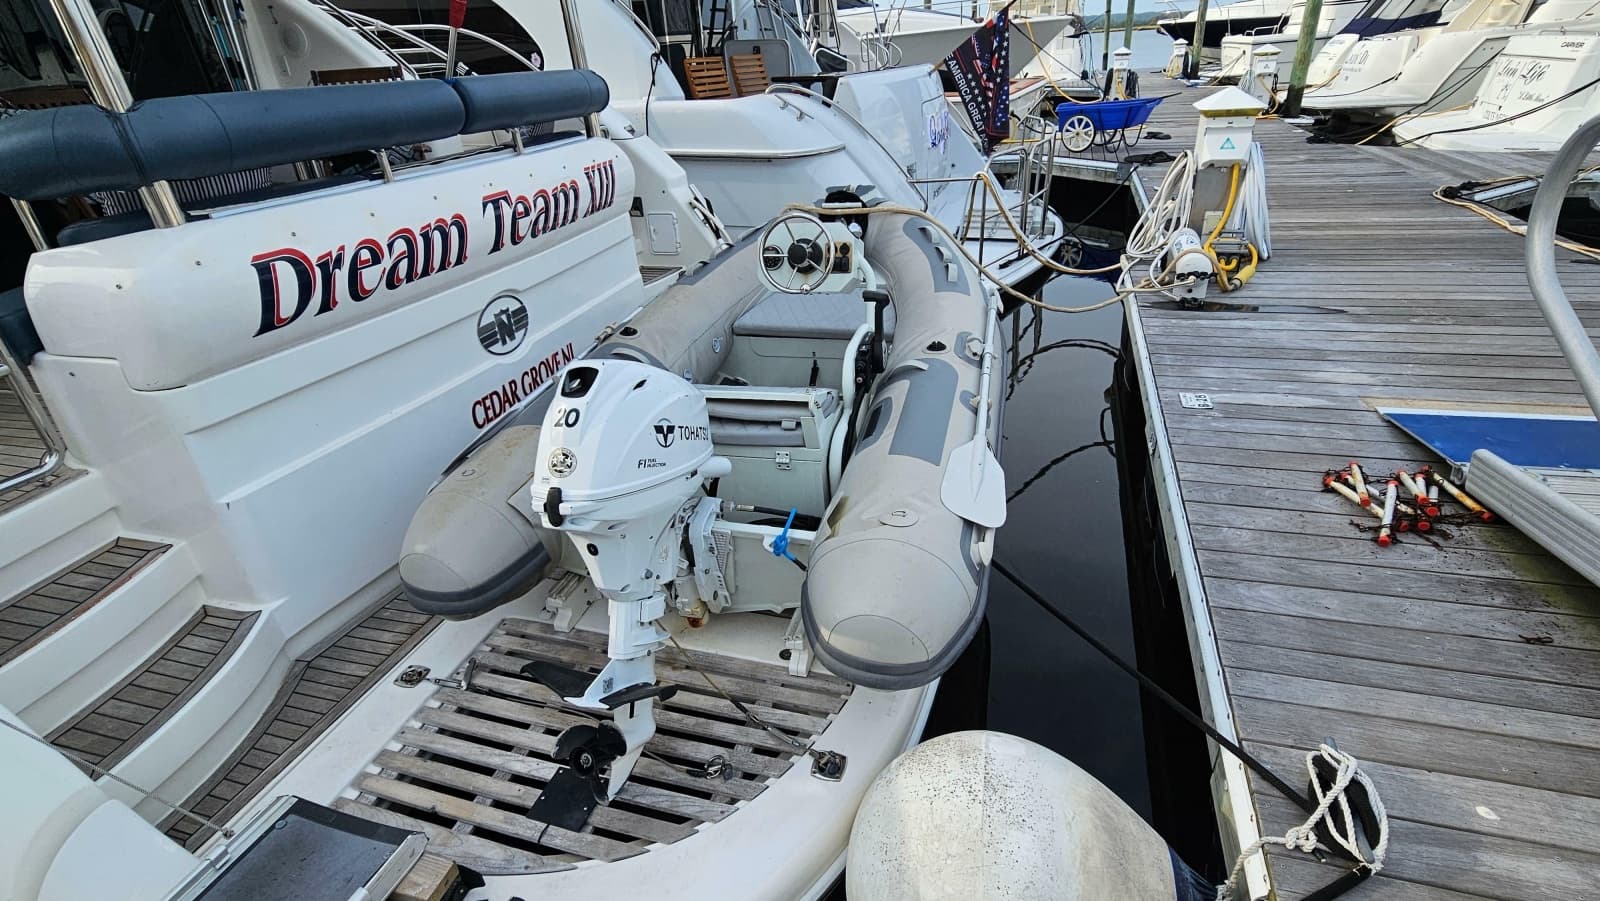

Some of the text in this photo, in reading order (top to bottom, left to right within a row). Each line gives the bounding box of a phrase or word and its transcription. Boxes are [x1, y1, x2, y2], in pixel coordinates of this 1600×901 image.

[1560, 41, 1586, 49] CARVER
[947, 59, 973, 104] AMERICA
[967, 102, 986, 134] GREAT
[250, 159, 616, 339] Dream Team XIII
[471, 378, 522, 430] CEDAR
[520, 351, 562, 397] GROVE
[553, 407, 581, 429] 20
[678, 424, 710, 441] TOHATSU
